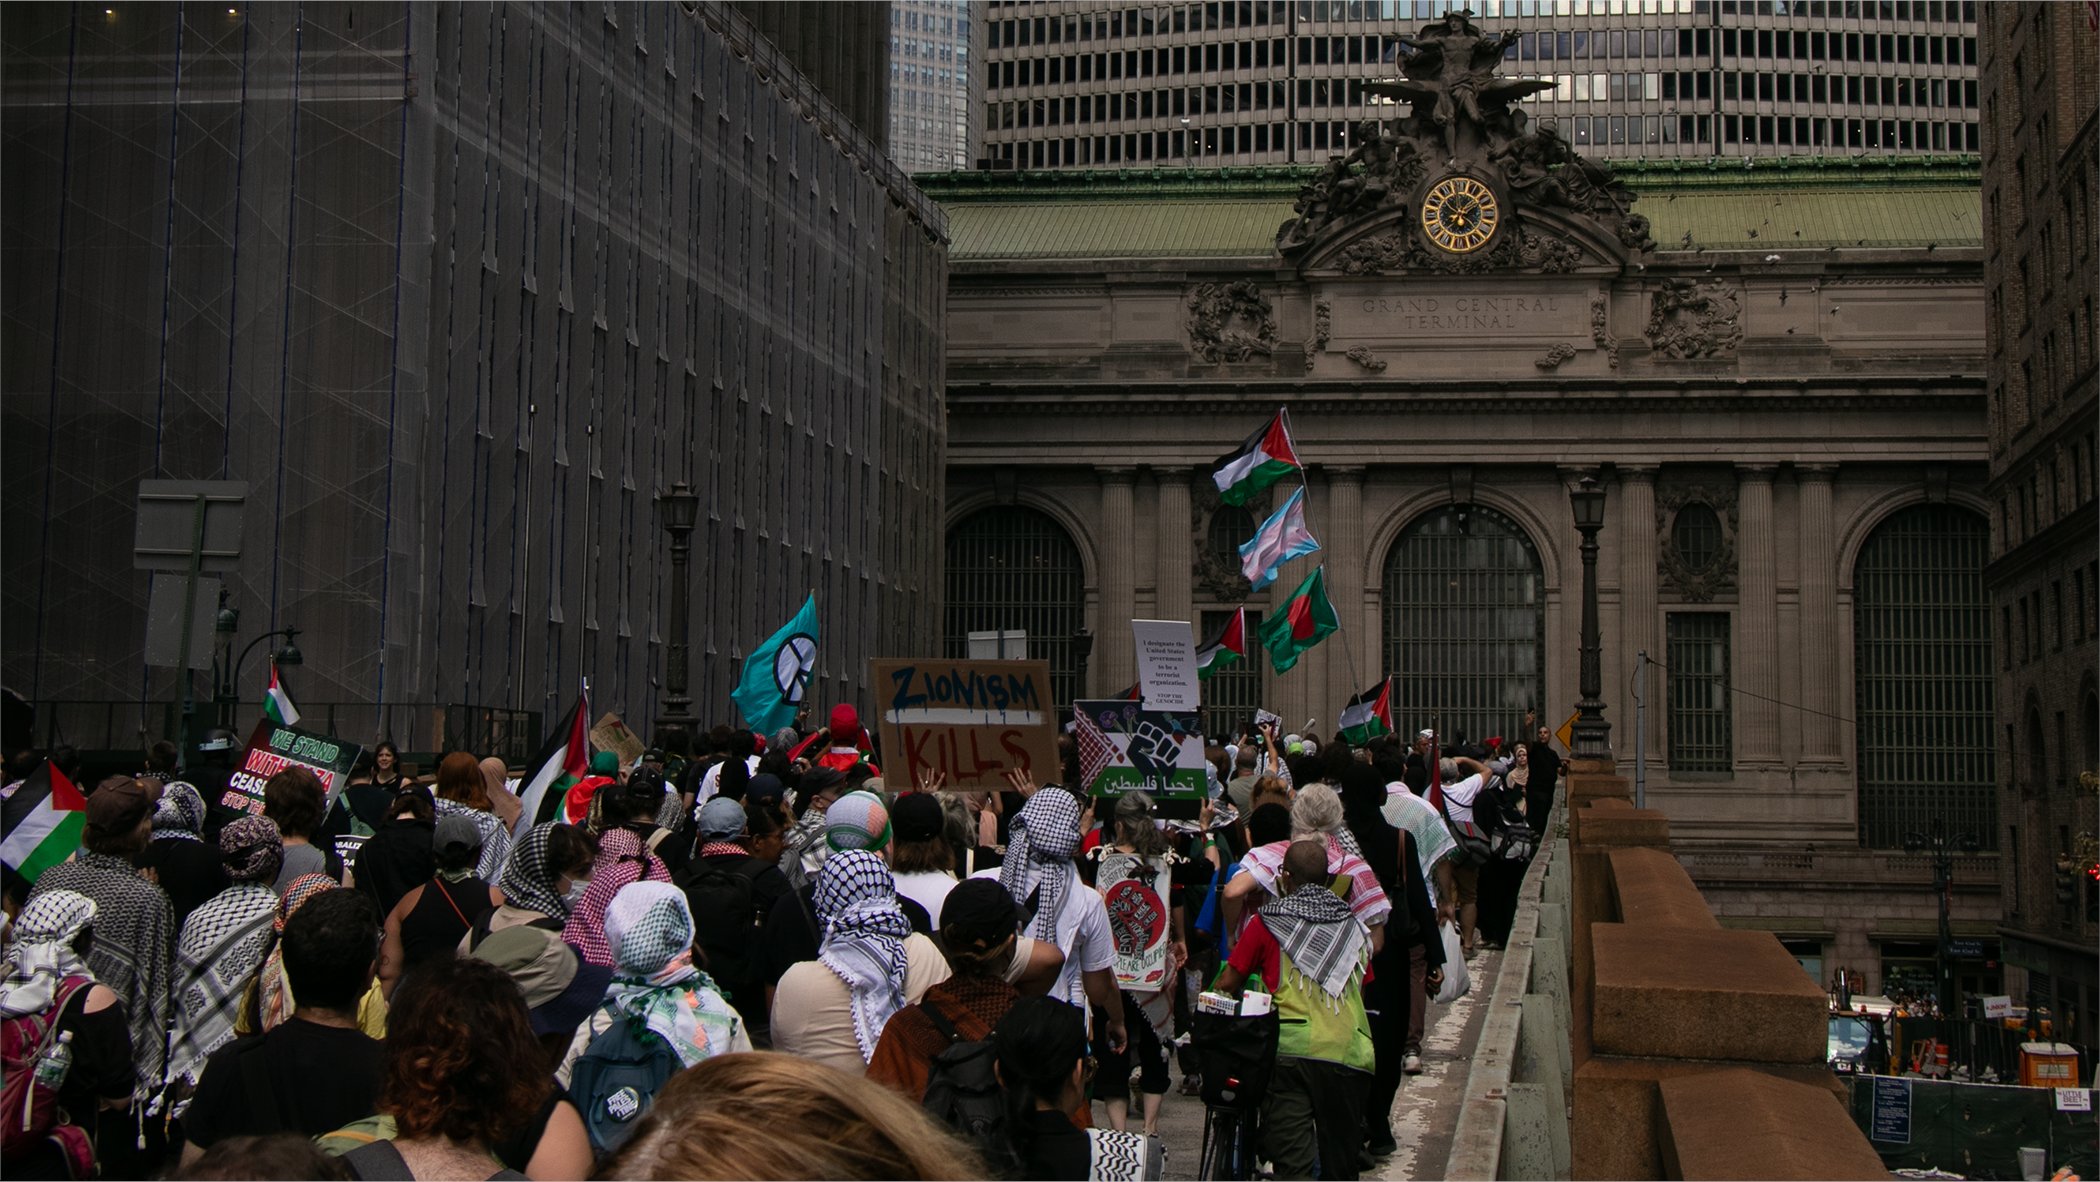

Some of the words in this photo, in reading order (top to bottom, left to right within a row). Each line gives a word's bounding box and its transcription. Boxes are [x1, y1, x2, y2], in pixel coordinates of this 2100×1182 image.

[1362, 299, 1440, 313] GRAND
[1455, 298, 1559, 312] CENTRAL
[1404, 315, 1516, 329] TERMINAL
[891, 666, 1041, 710] ZIONISM
[269, 728, 296, 750] WE
[292, 735, 339, 763] STAND
[245, 748, 290, 778] WITH
[904, 726, 1031, 791] KILLS
[1104, 774, 1158, 794] فلسطين
[1163, 775, 1195, 796] تحيا
[221, 791, 250, 810] STOP
